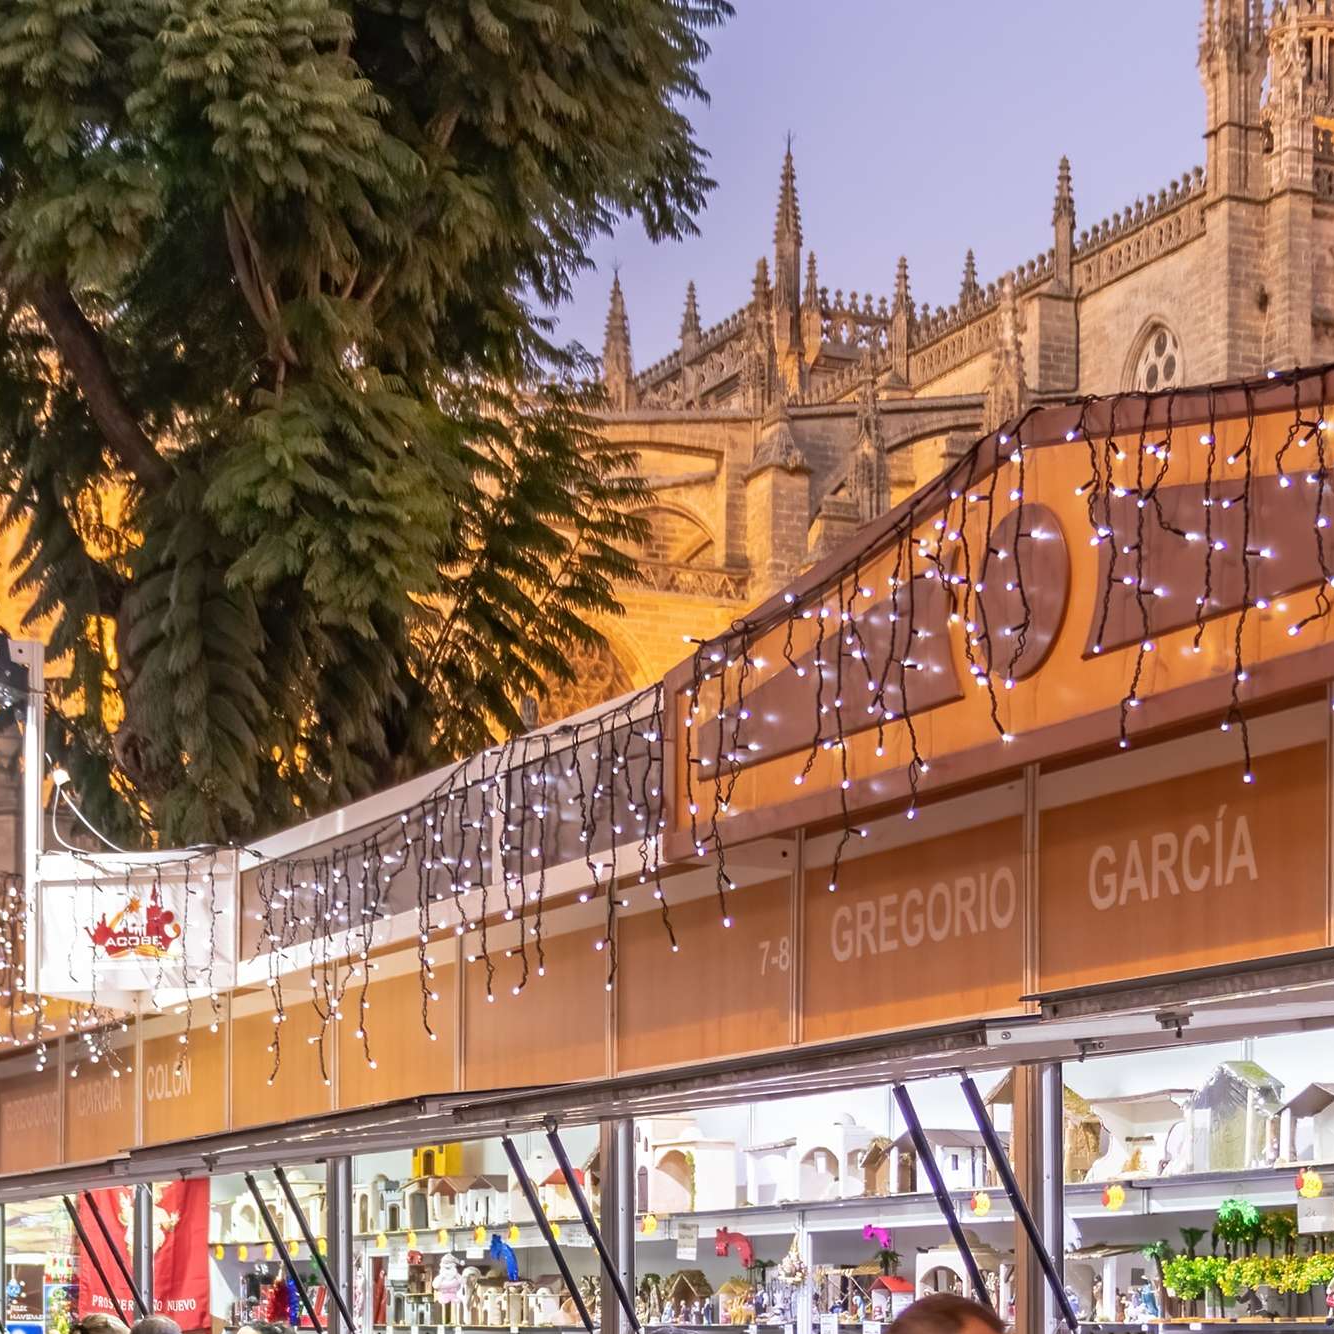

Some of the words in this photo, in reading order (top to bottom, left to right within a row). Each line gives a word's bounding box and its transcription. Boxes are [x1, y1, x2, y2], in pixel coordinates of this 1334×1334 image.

[758, 935, 790, 976] 7-8
[829, 866, 1017, 963] GREGORIO
[1087, 804, 1259, 910] GARCÍA
[146, 1054, 192, 1102] COLÓN
[167, 1298, 197, 1312] NUEVO
